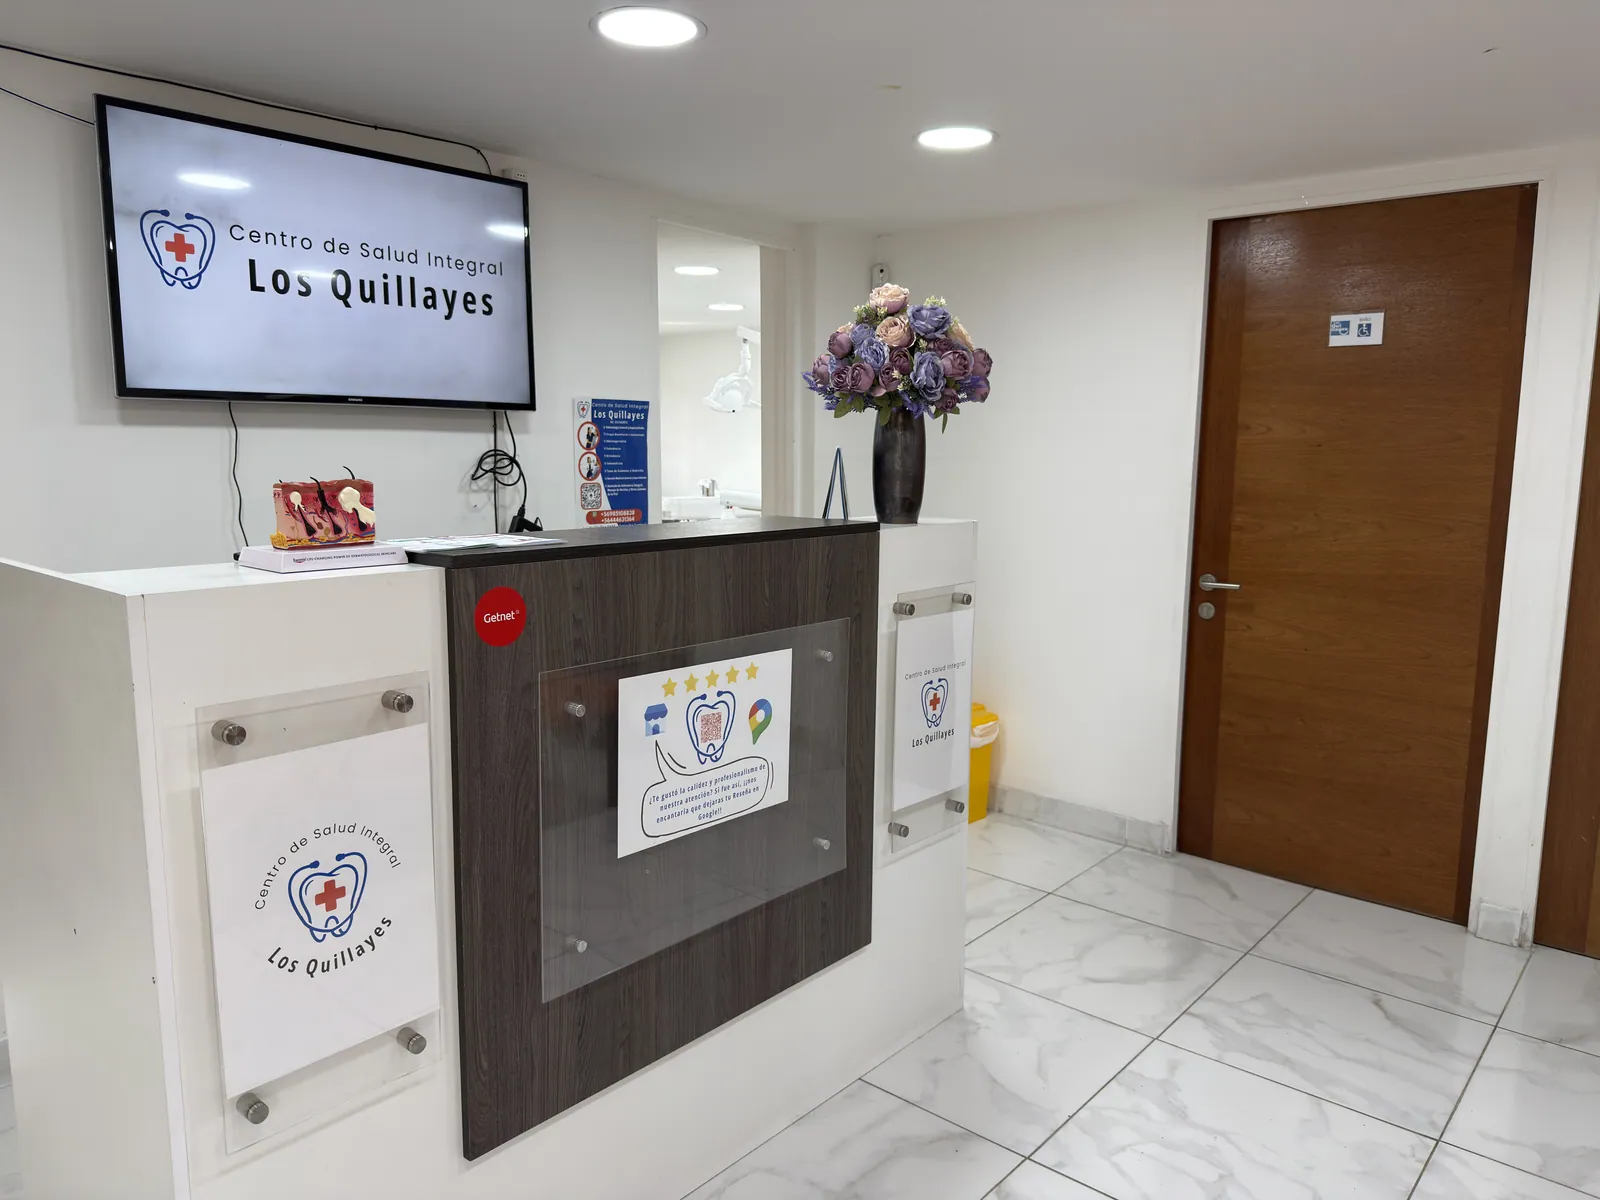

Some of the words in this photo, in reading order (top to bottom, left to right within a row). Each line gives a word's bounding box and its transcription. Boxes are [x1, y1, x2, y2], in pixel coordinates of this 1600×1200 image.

[229, 224, 313, 251] Centro
[323, 237, 350, 255] de
[360, 242, 419, 265] Salud
[427, 251, 504, 277] Integral
[248, 258, 312, 297] Los
[331, 268, 494, 321] Quillayes
[594, 410, 606, 418] Los
[608, 410, 645, 421] Quillayes
[484, 610, 515, 623] Getnet
[905, 671, 922, 680] Centro
[932, 665, 946, 674] Salud
[947, 660, 966, 669] Integral
[912, 738, 923, 748] Los
[925, 728, 955, 744] Quillayes
[649, 795, 659, 805] ¿Te
[661, 790, 678, 801] gustó
[687, 781, 708, 792] calidez
[714, 767, 758, 786] profesionalismo
[660, 800, 683, 811] nuestra
[685, 790, 713, 803] atención?
[691, 804, 701, 814] que
[703, 798, 724, 809] dejaras
[732, 789, 752, 798] Reseña
[698, 807, 722, 821] Google!!
[255, 856, 286, 910] Centro
[289, 837, 308, 854] de
[313, 823, 357, 839] Salud
[360, 825, 401, 868] Integral
[267, 947, 299, 973] Los
[306, 916, 392, 978] Quillayes
